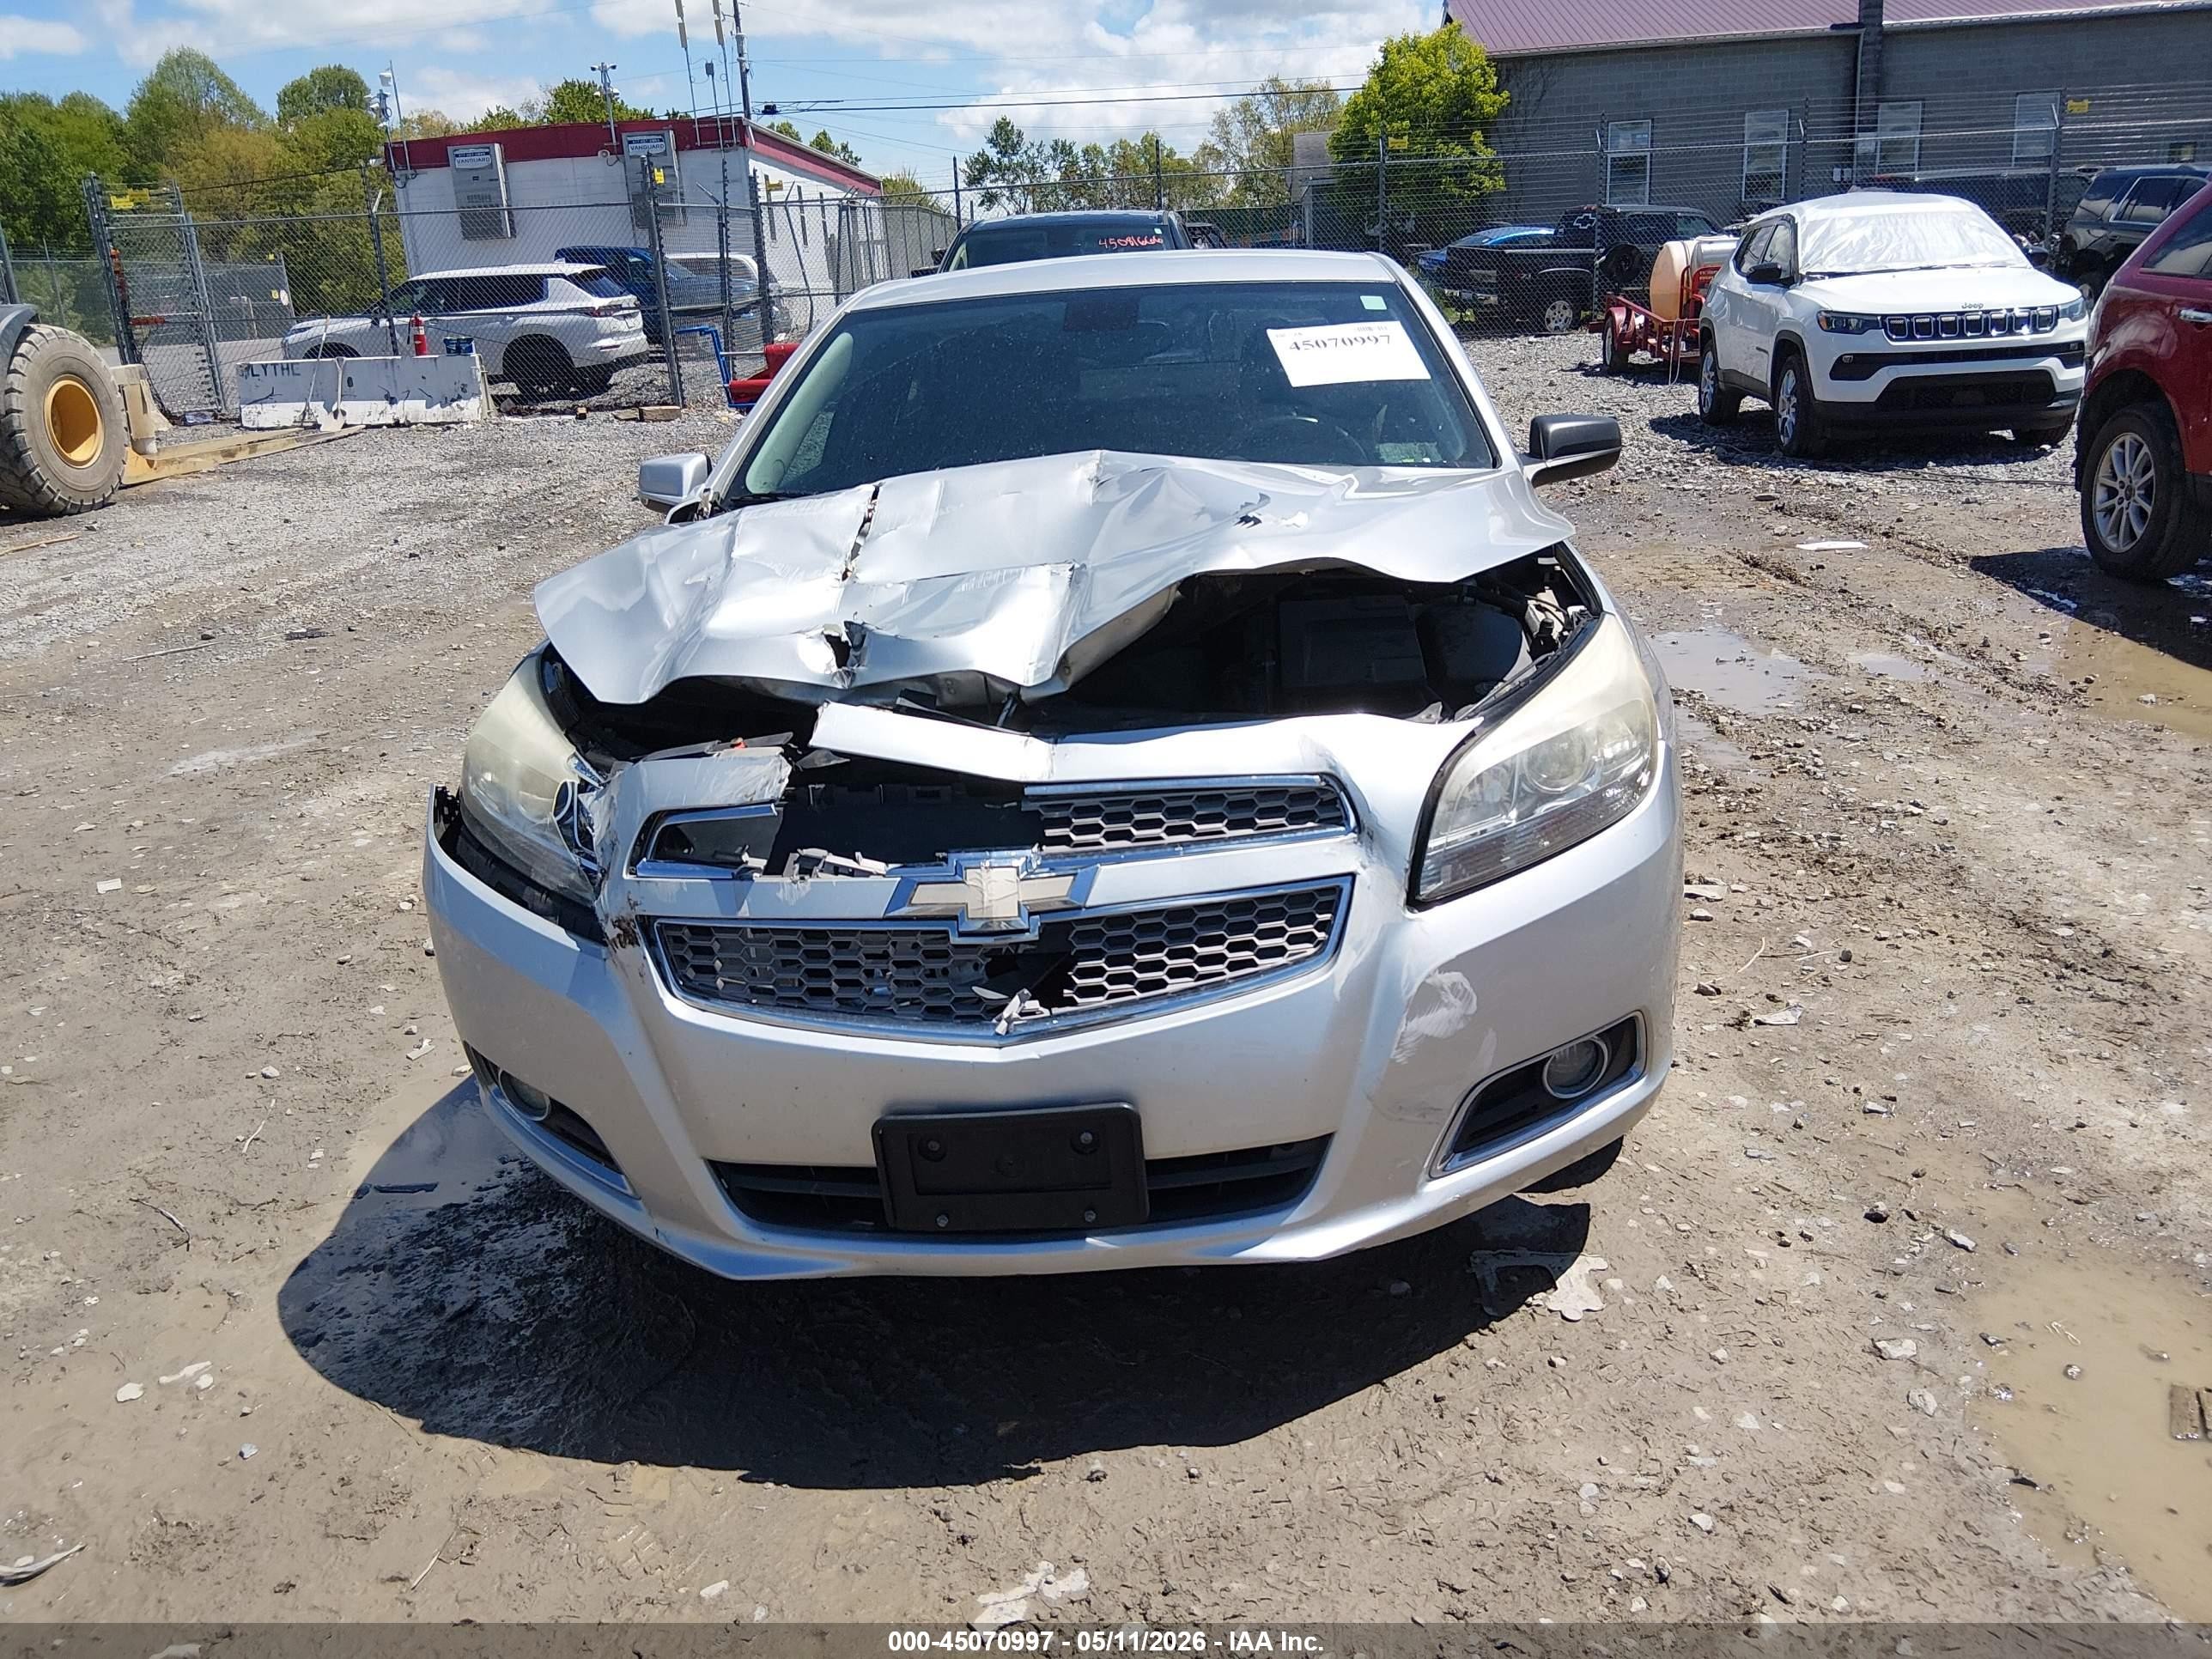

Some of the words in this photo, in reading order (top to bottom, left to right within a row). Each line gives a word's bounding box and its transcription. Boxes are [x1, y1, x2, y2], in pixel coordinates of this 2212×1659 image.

[1961, 301, 1984, 310] Jeep
[1289, 335, 1391, 351] 45070997
[240, 362, 301, 378] LYTHE
